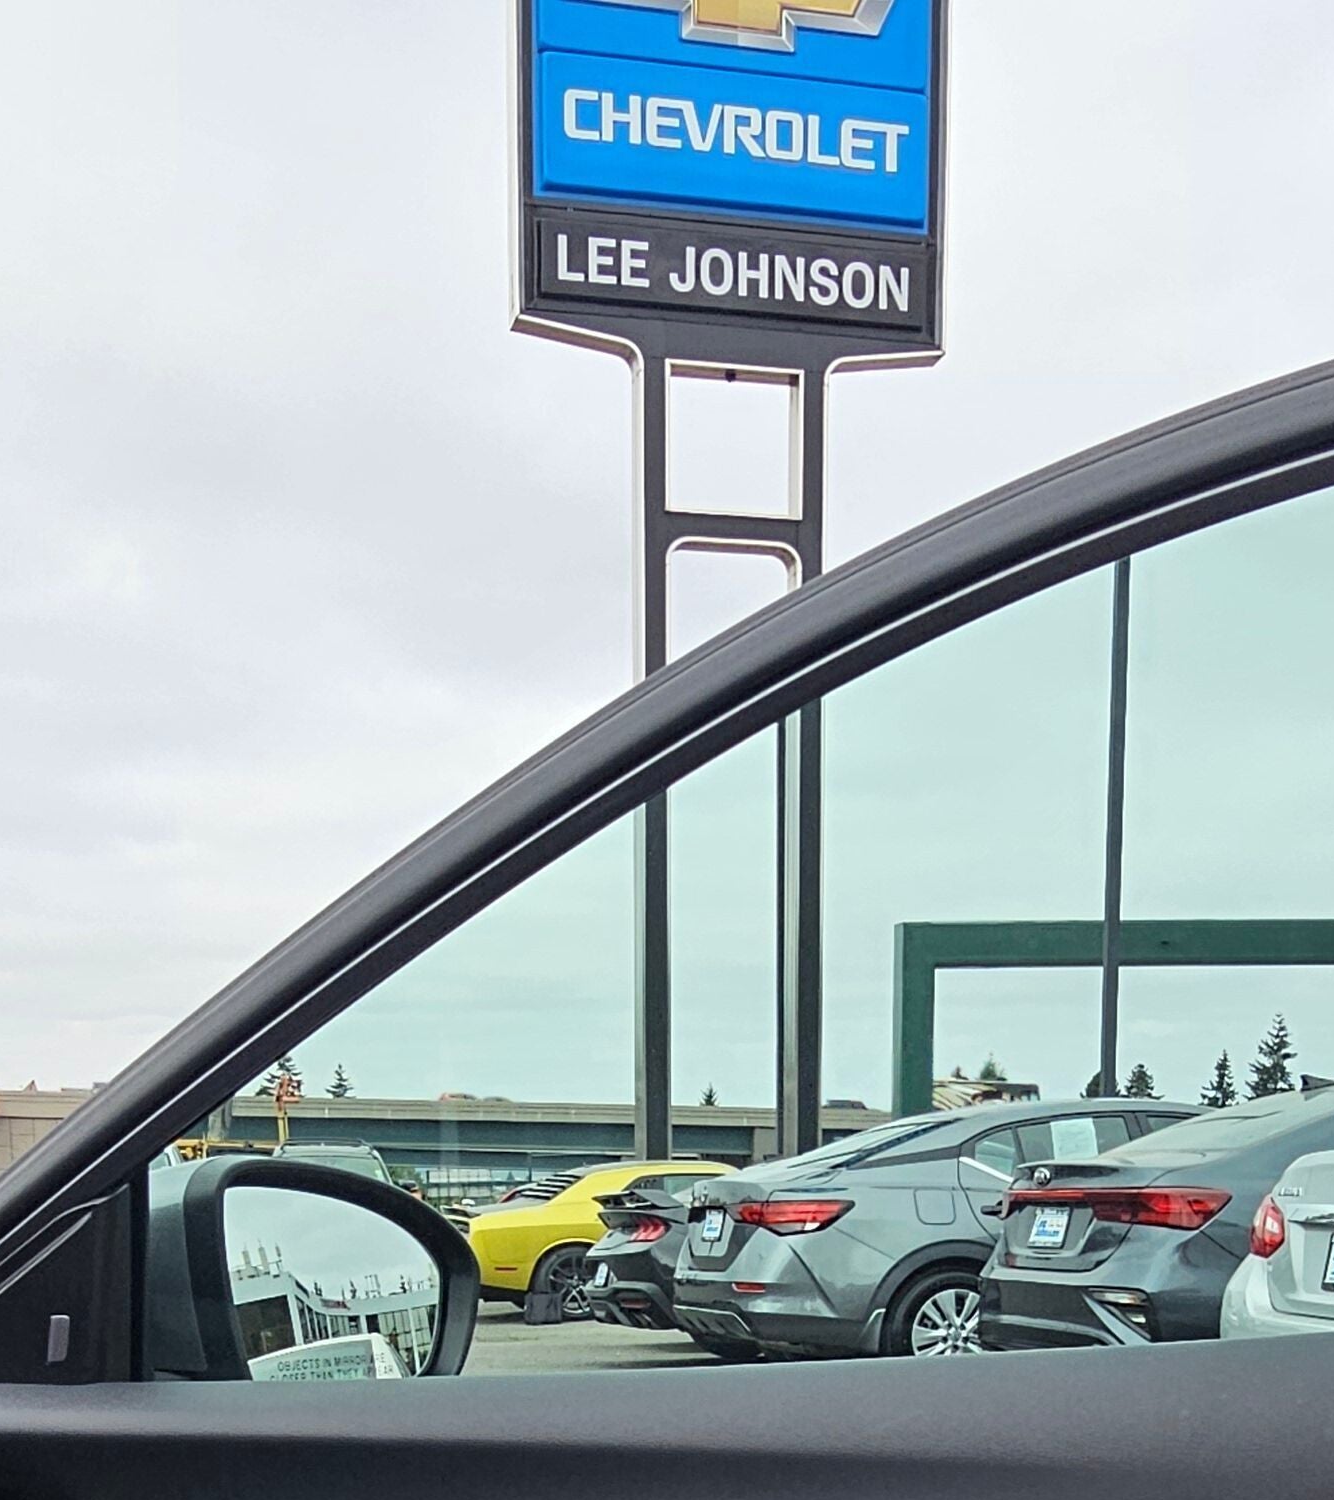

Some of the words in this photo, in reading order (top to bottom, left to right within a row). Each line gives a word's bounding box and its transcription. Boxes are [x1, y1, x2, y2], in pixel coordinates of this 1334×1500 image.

[563, 89, 910, 173] CHEVROLET
[557, 234, 650, 288] LEE
[669, 246, 910, 312] JOHNSON
[277, 1358, 320, 1372] OBJECTS
